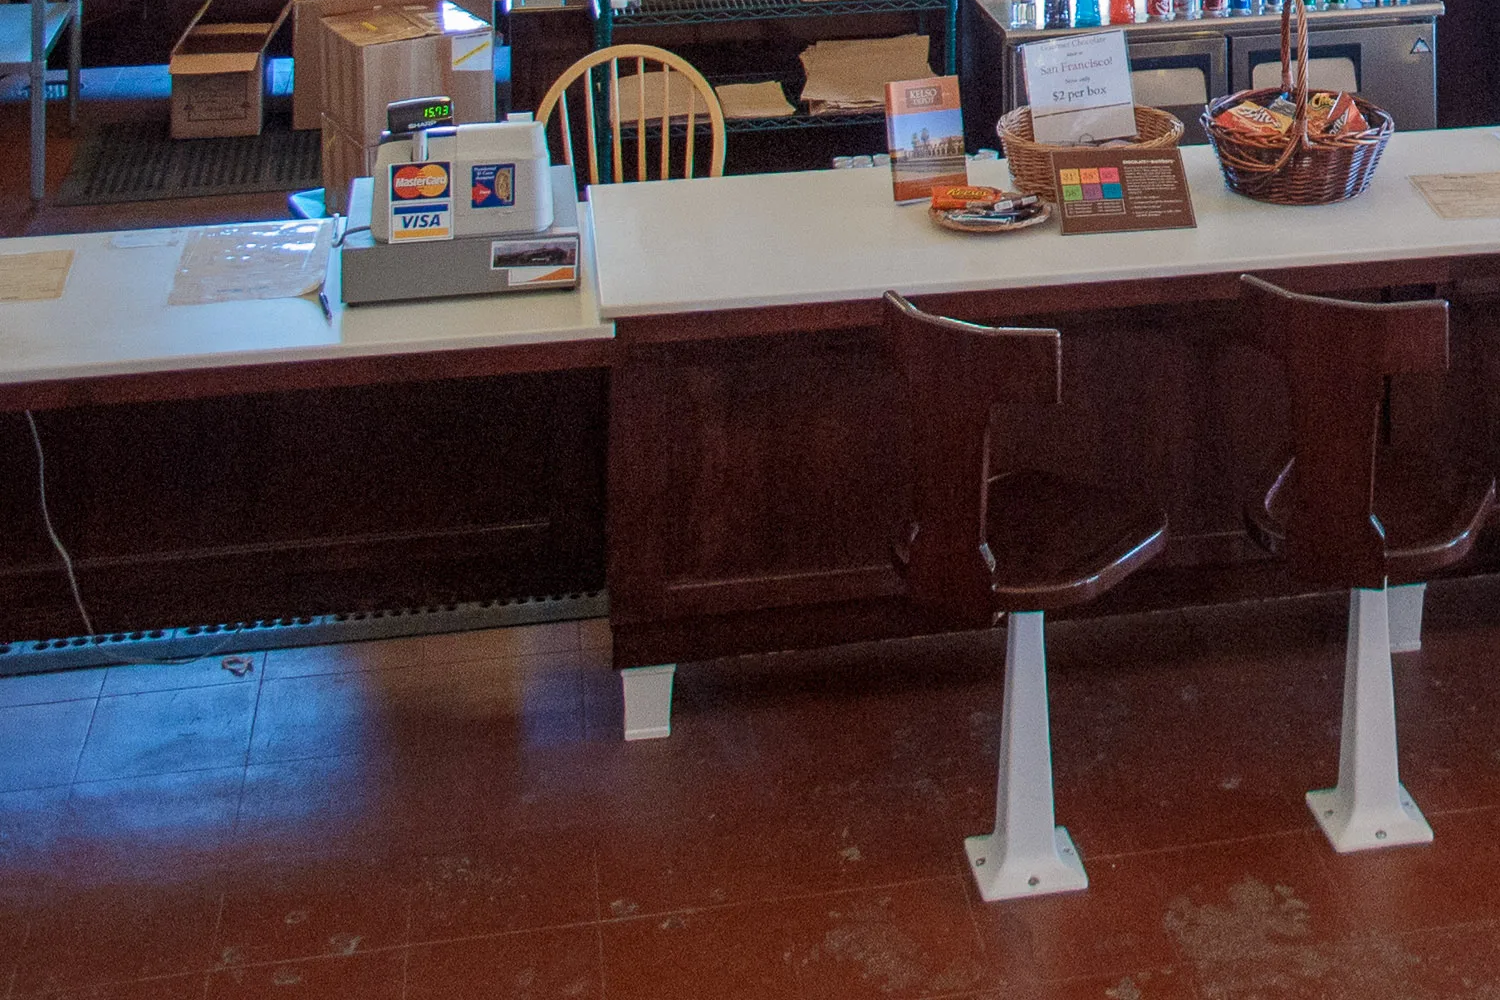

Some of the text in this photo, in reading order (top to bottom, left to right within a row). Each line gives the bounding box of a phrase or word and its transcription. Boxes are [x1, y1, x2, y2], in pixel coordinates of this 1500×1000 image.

[1040, 57, 1113, 76] San Francisco!
[910, 89, 937, 99] KELSO
[1052, 85, 1107, 101] $2 per box
[408, 120, 437, 130] SHARP
[396, 174, 447, 188] MasterCard
[402, 213, 441, 229] VISA
